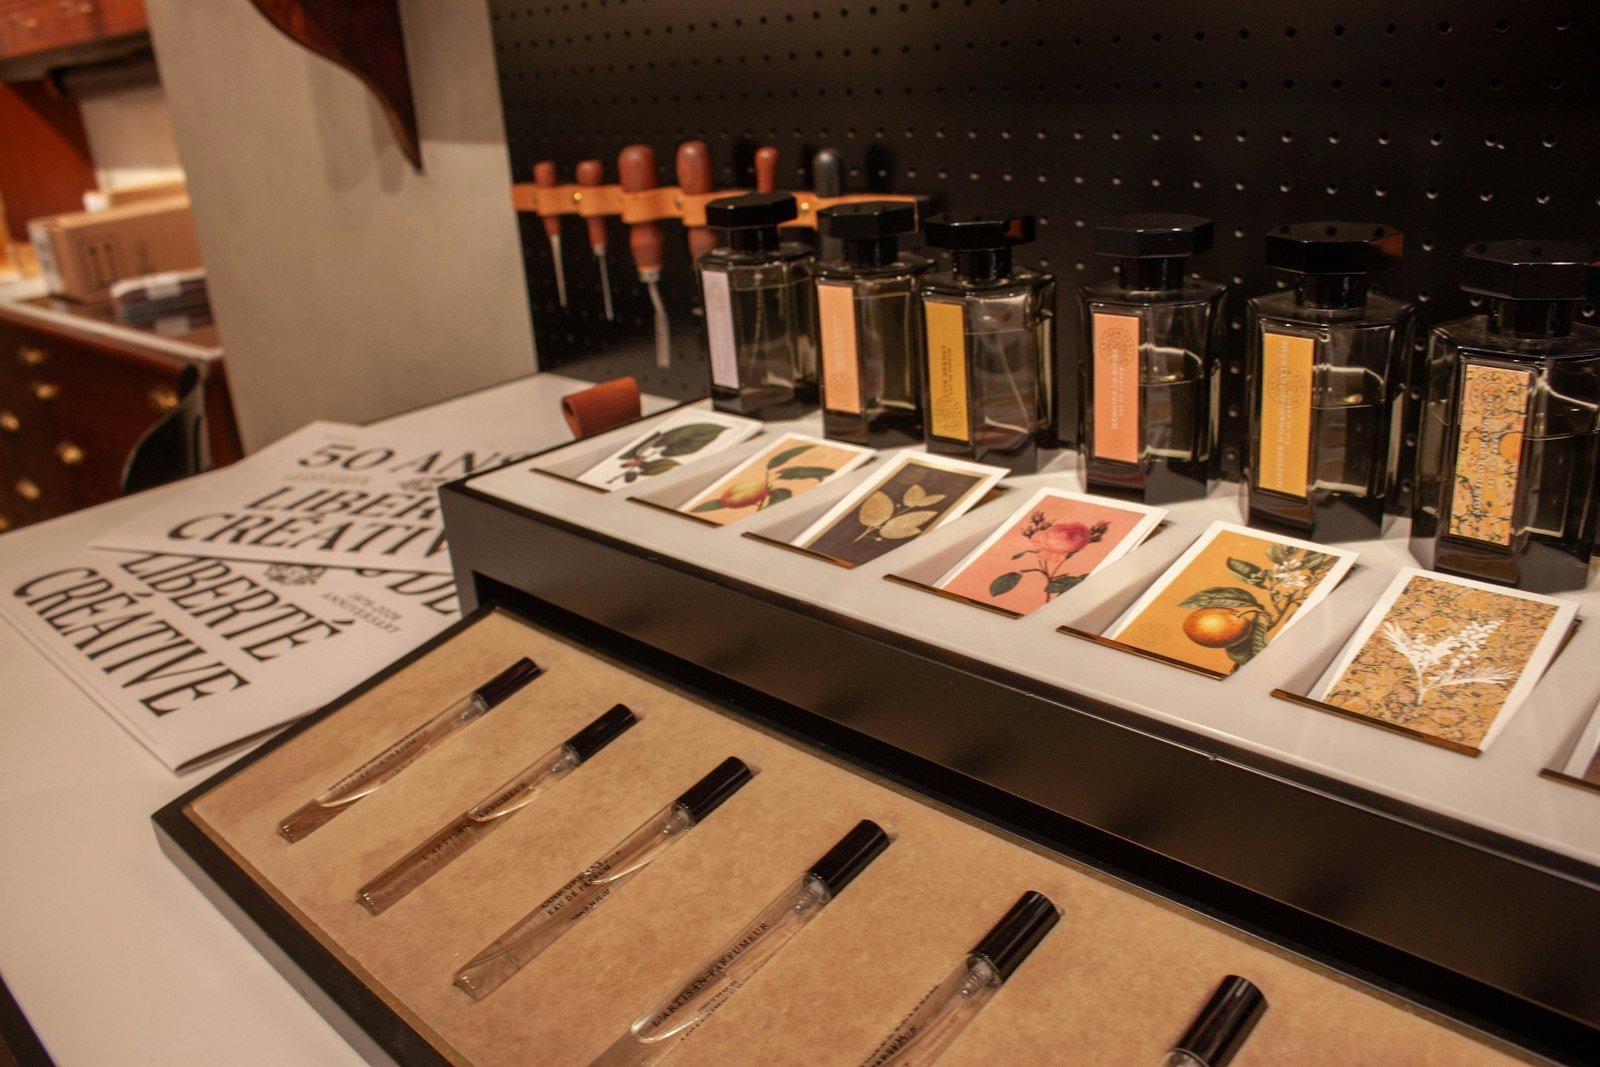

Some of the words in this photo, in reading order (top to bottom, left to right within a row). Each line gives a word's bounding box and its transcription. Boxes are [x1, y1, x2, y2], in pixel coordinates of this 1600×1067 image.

[298, 444, 395, 472] 50
[13, 566, 252, 718] CRÉATIVE
[119, 551, 356, 663] LIBERTÉ
[547, 900, 565, 916] EAU
[651, 975, 708, 1029] L'ARTISAN
[707, 922, 768, 978] PARFUMEUR
